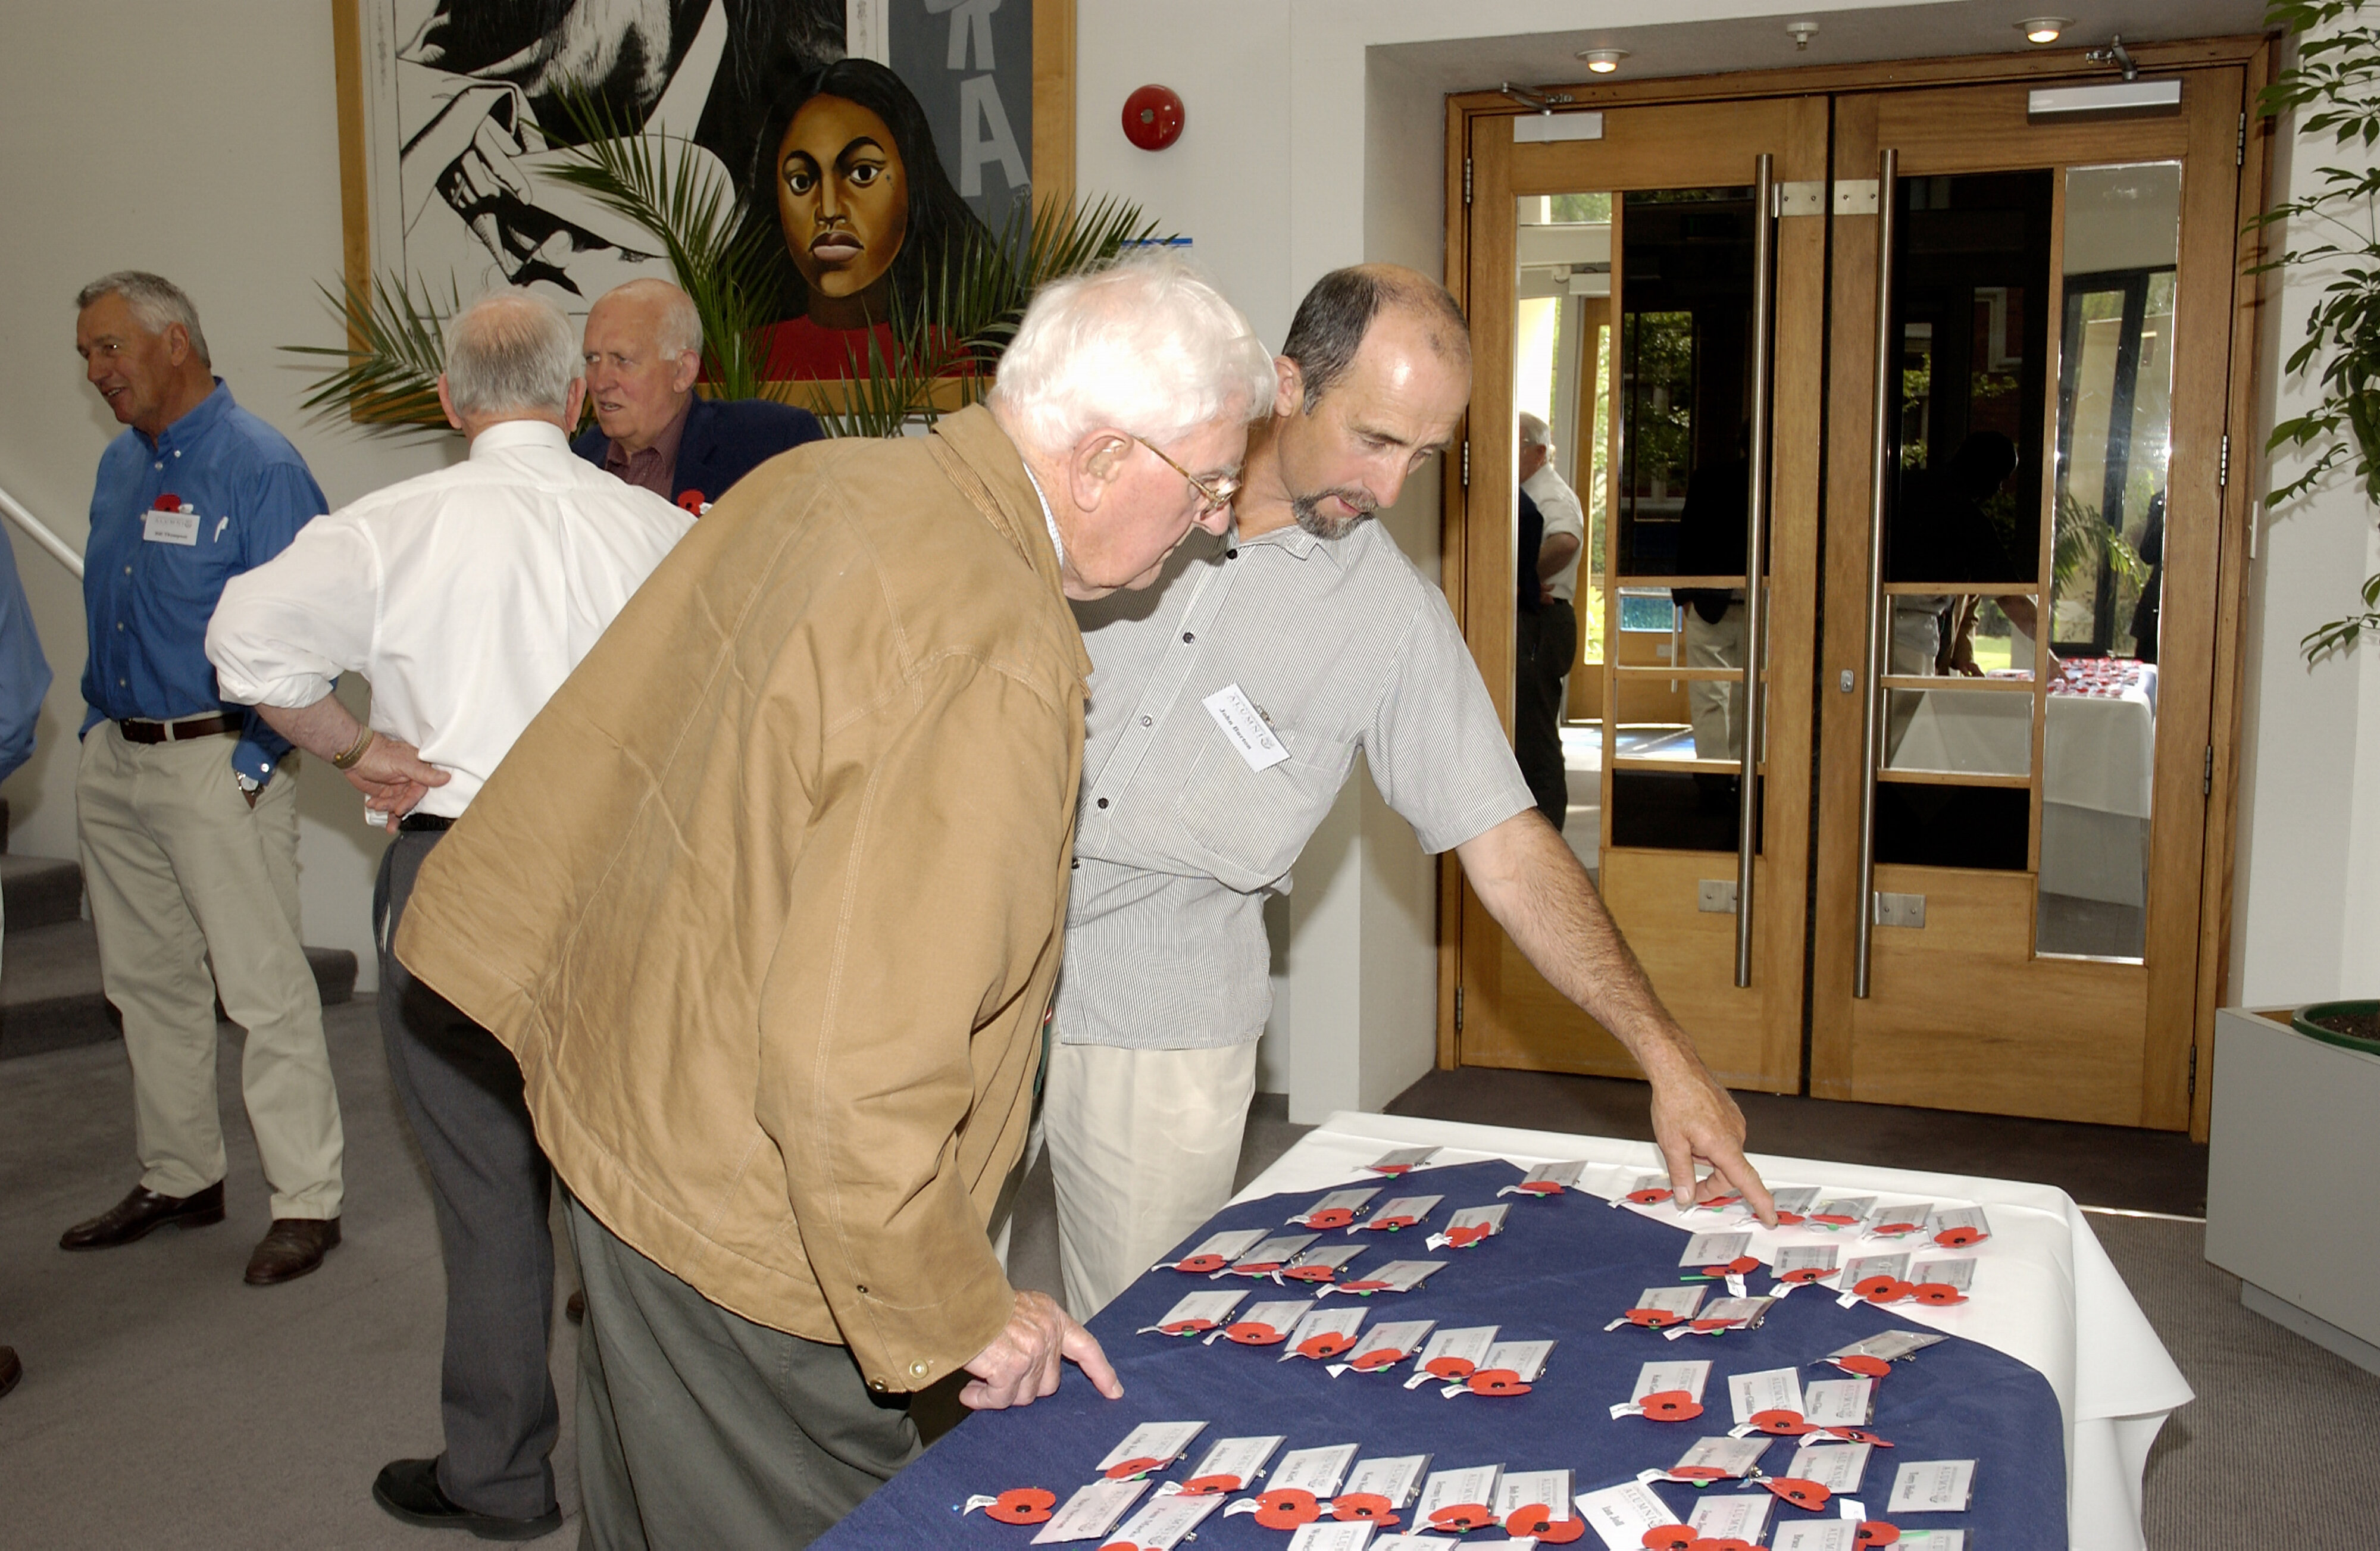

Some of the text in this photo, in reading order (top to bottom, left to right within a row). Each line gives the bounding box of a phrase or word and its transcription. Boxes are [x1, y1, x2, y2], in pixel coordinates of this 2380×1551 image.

[1218, 707, 1235, 726] John
[1228, 694, 1264, 738] ALUMNI
[1622, 1488, 1659, 1521] ALUMNI
[1724, 1503, 1746, 1534] ALUMNI
